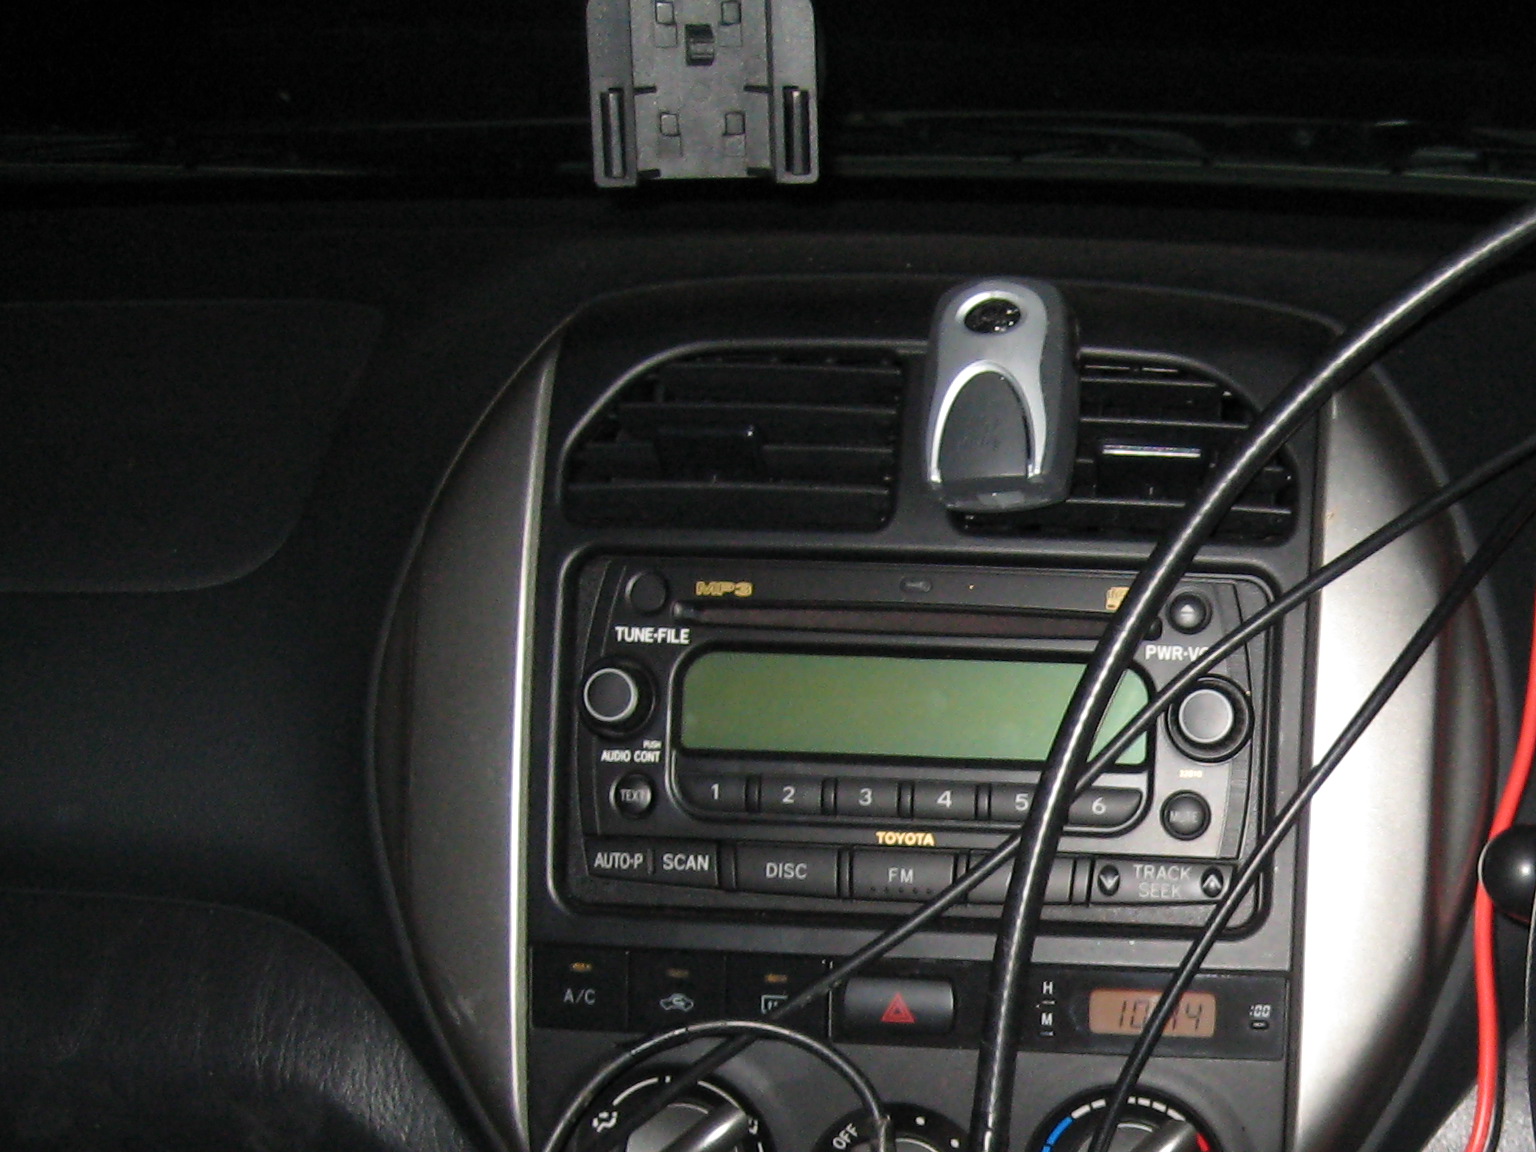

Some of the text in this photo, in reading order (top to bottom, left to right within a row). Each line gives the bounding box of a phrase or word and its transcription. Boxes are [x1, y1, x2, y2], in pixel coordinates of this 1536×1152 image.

[695, 581, 753, 597] MP3
[601, 750, 661, 763] AUDIO CONT
[710, 784, 720, 800] 1
[782, 786, 795, 803] 2
[858, 788, 873, 805] 3
[936, 790, 953, 807] 4
[1015, 793, 1029, 810] 5
[1091, 797, 1107, 814] 6
[1169, 809, 1199, 823] MUTE
[876, 831, 935, 847] TOYOTA
[663, 854, 709, 871] SCAN
[766, 862, 808, 879] DISC
[888, 868, 914, 884] FM
[1133, 863, 1192, 882] TRACK
[1138, 881, 1183, 899] SEEK
[563, 988, 596, 1005] A/C
[1042, 981, 1053, 995] H
[1041, 1013, 1053, 1026] M
[832, 1123, 859, 1151] OFF
